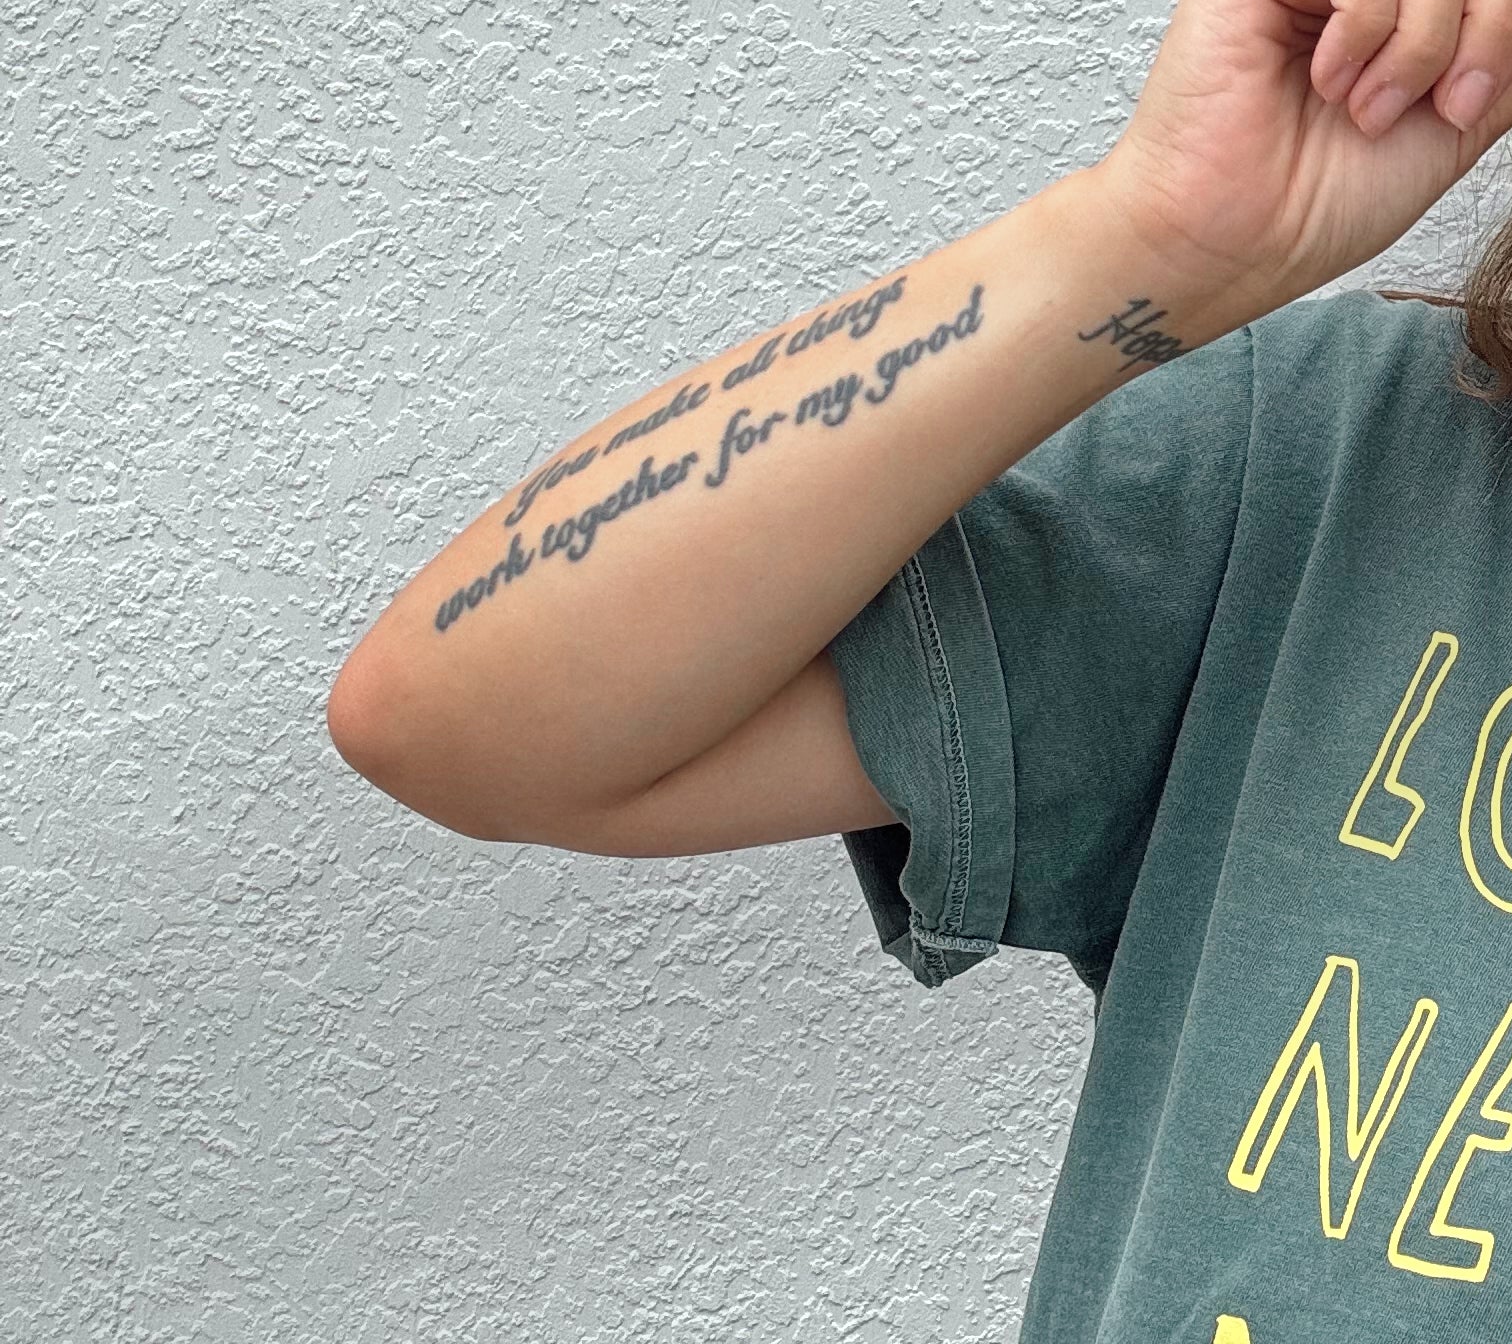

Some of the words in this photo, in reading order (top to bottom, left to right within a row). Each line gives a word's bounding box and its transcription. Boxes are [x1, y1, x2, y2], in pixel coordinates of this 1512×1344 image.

[434, 532, 536, 634] work
[540, 450, 699, 563] together
[704, 407, 787, 489] for
[795, 372, 864, 427] my
[865, 283, 985, 404] good
[602, 382, 711, 456] make
[721, 332, 787, 391] all
[786, 275, 908, 356] things
